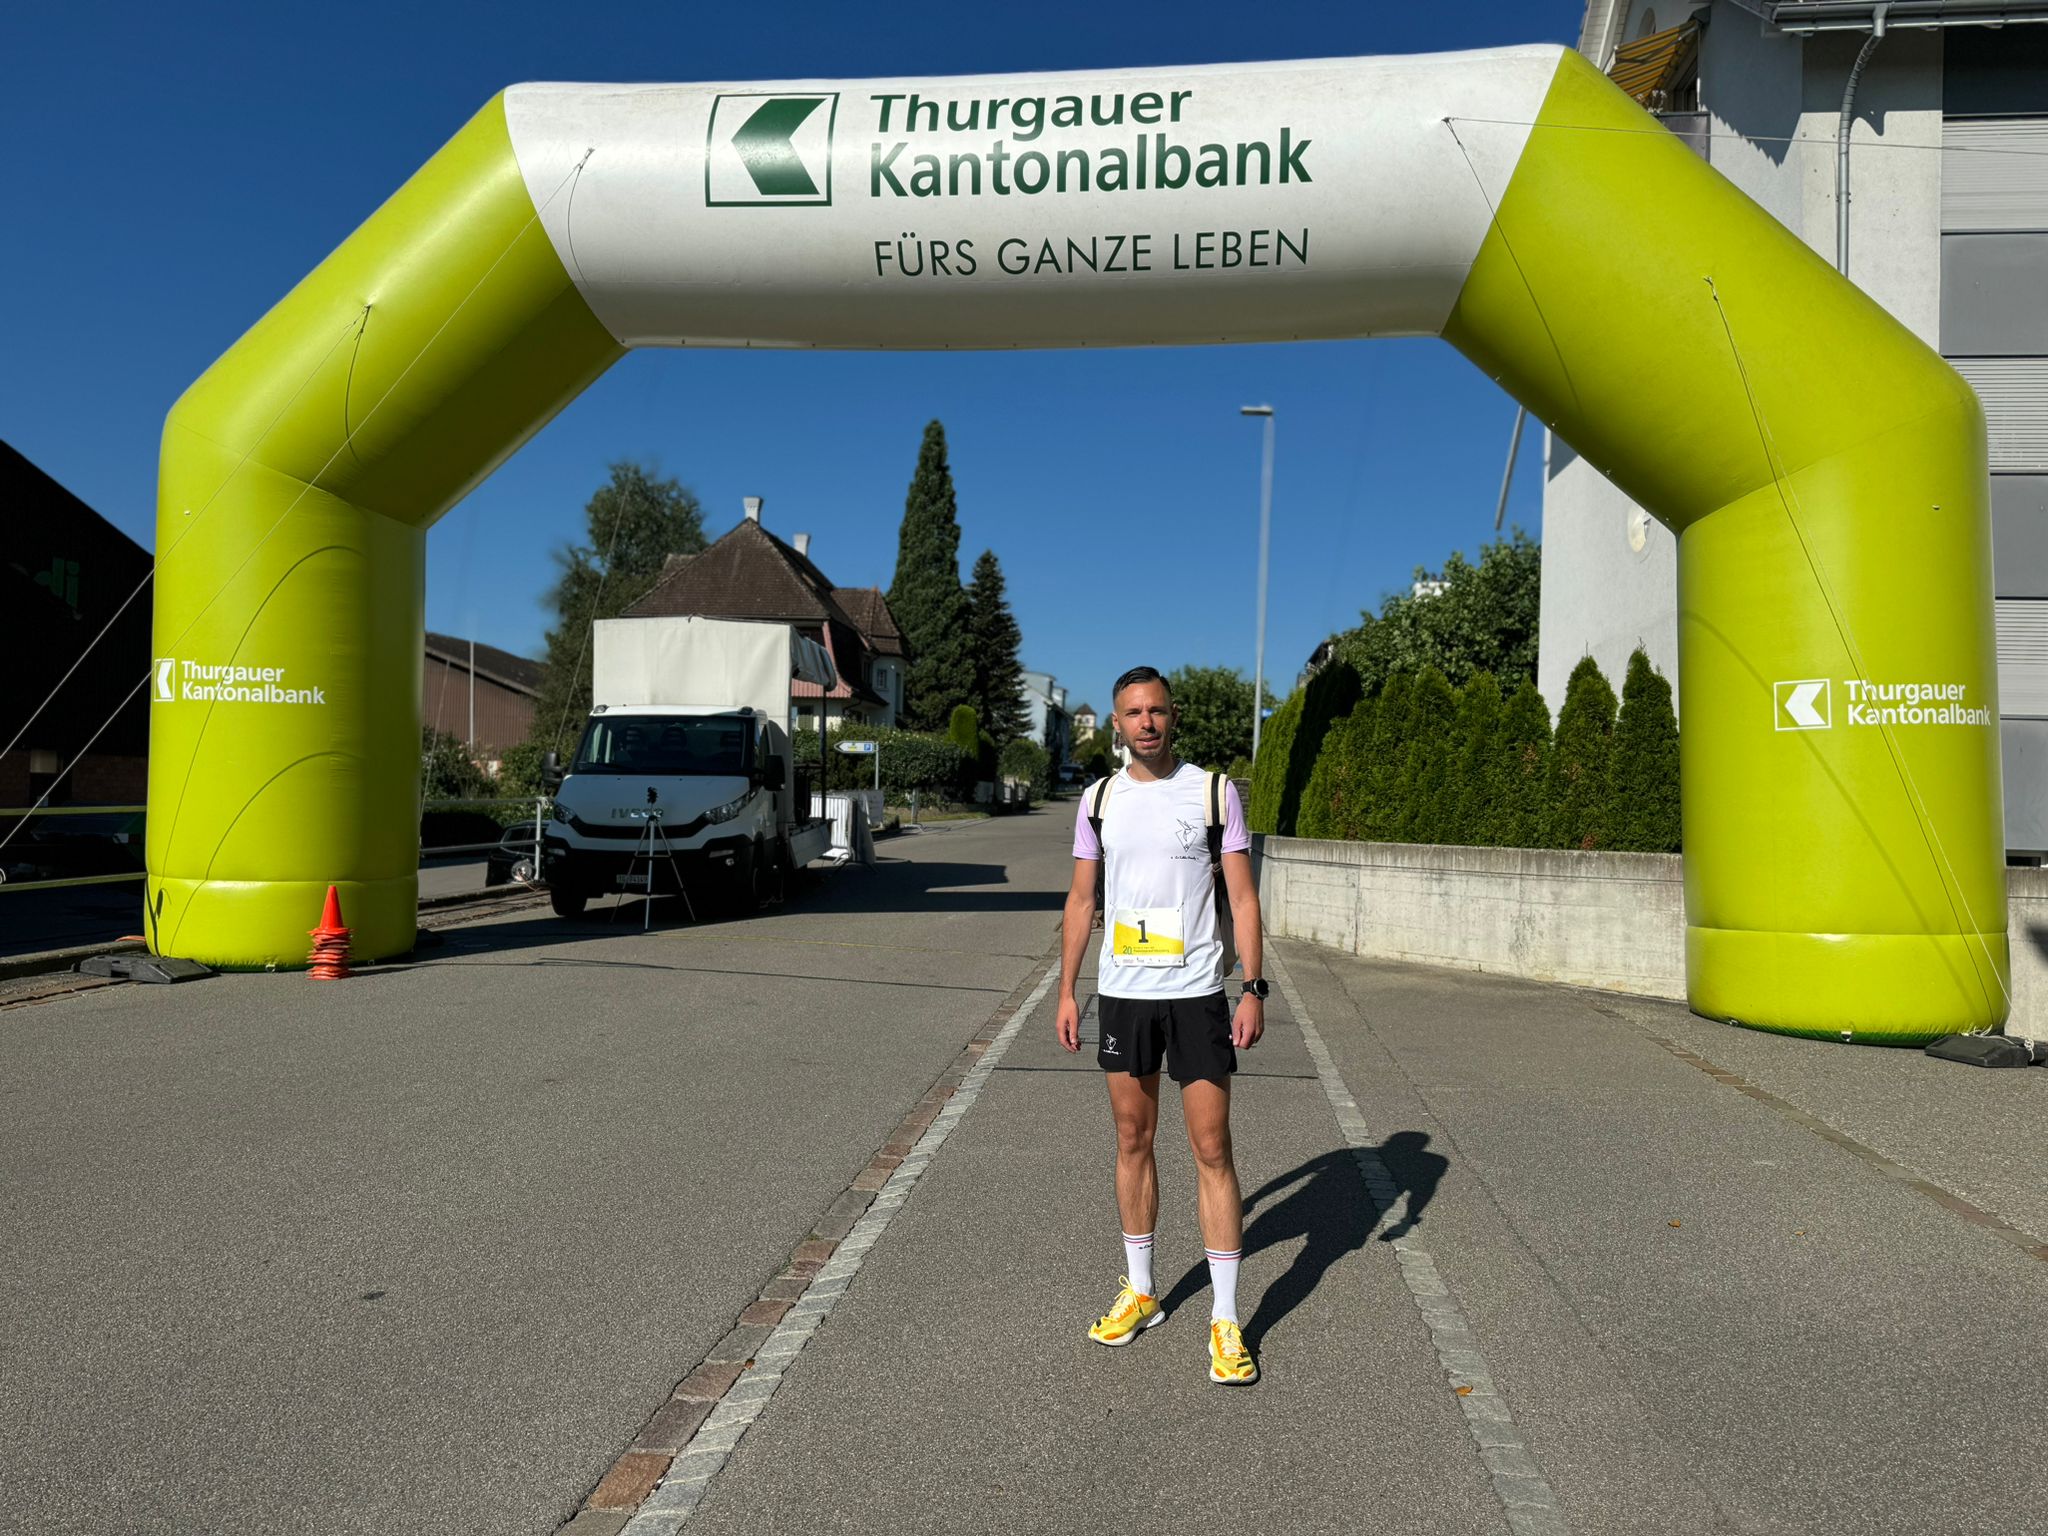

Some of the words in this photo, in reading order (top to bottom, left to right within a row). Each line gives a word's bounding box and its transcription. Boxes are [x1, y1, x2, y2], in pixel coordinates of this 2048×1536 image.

[870, 90, 1192, 141] Thurgauer
[870, 127, 1313, 197] Kantonalbank
[874, 231, 978, 277] FÜRS
[997, 234, 1152, 275] GANZE
[1172, 228, 1309, 270] LEBEN
[181, 660, 285, 685] Thurgauer
[182, 681, 326, 705] Kantonalbank
[1844, 680, 1967, 705] Thurgauer
[1847, 703, 1991, 726] Kantonalbank
[1137, 920, 1149, 943] 1
